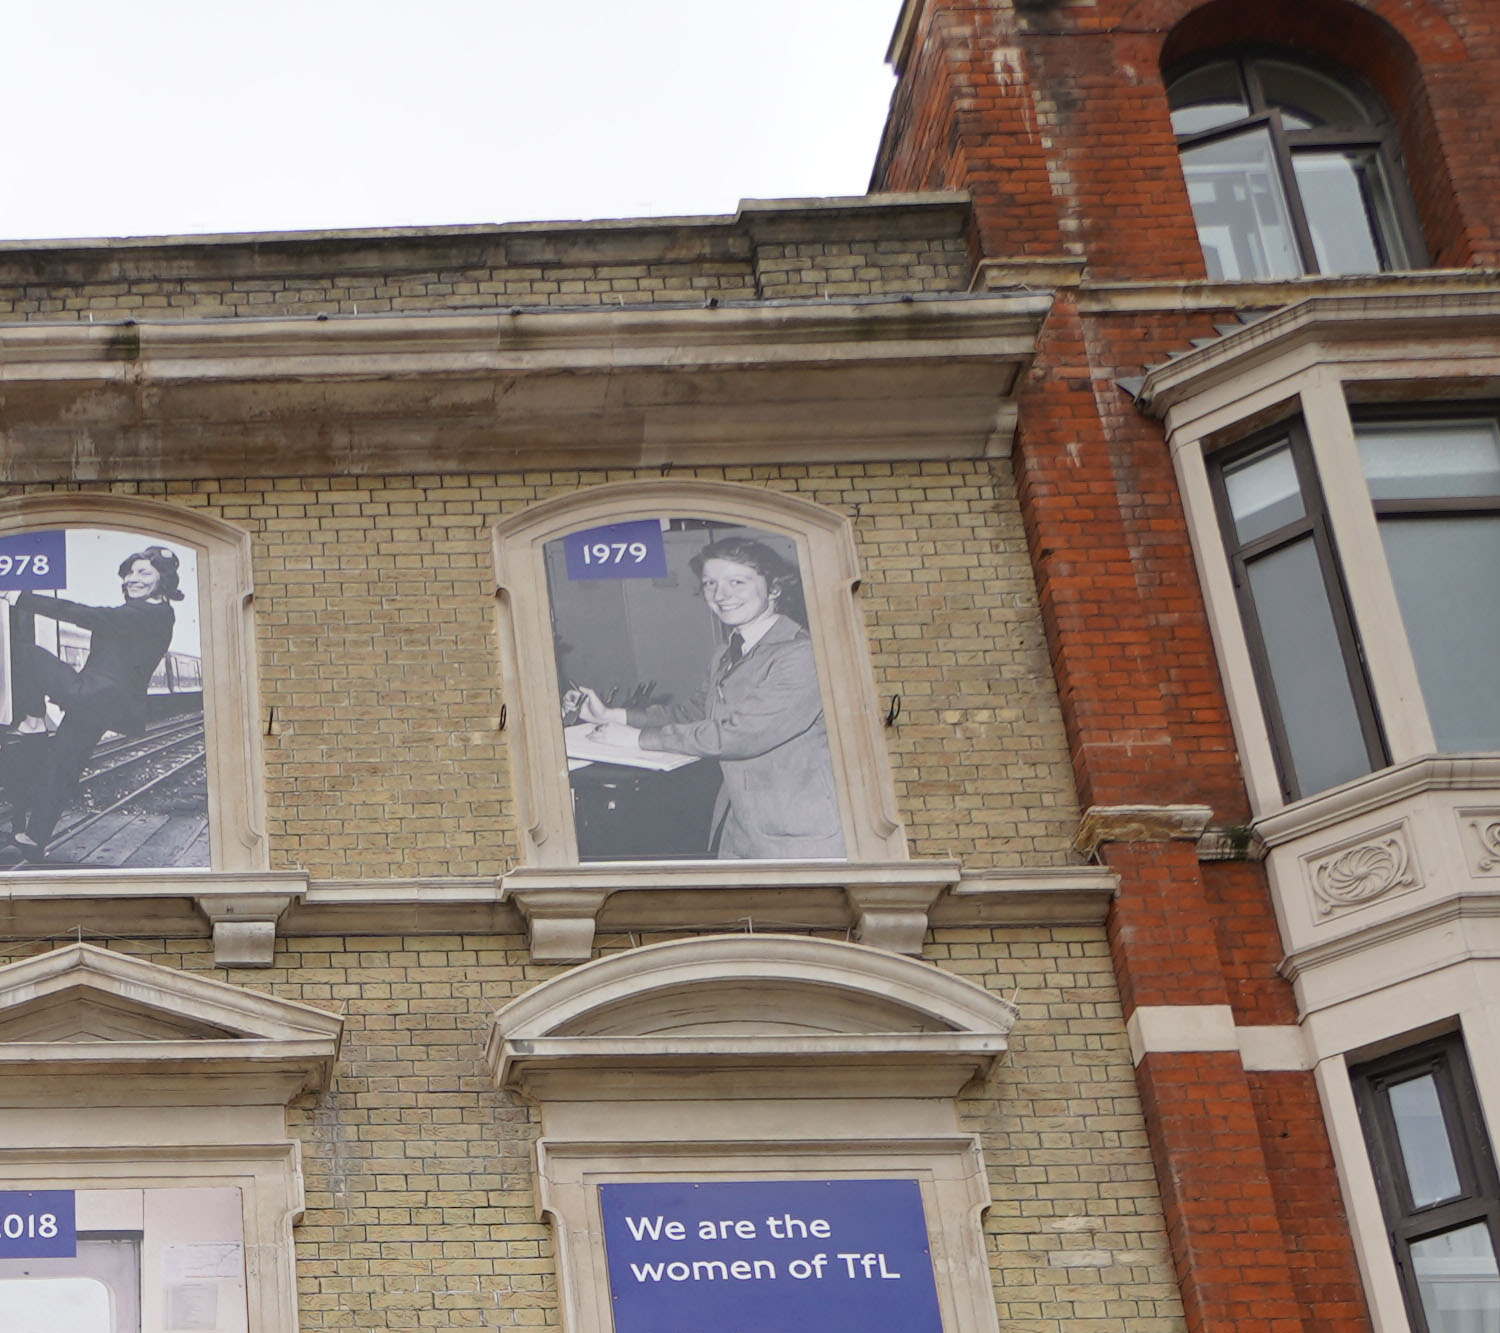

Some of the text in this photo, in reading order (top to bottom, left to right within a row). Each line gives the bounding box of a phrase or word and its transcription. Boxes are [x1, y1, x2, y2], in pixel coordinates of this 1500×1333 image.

[583, 542, 647, 564] 1979
[626, 1214, 830, 1240] We are the
[631, 1254, 900, 1281] women of TfL
